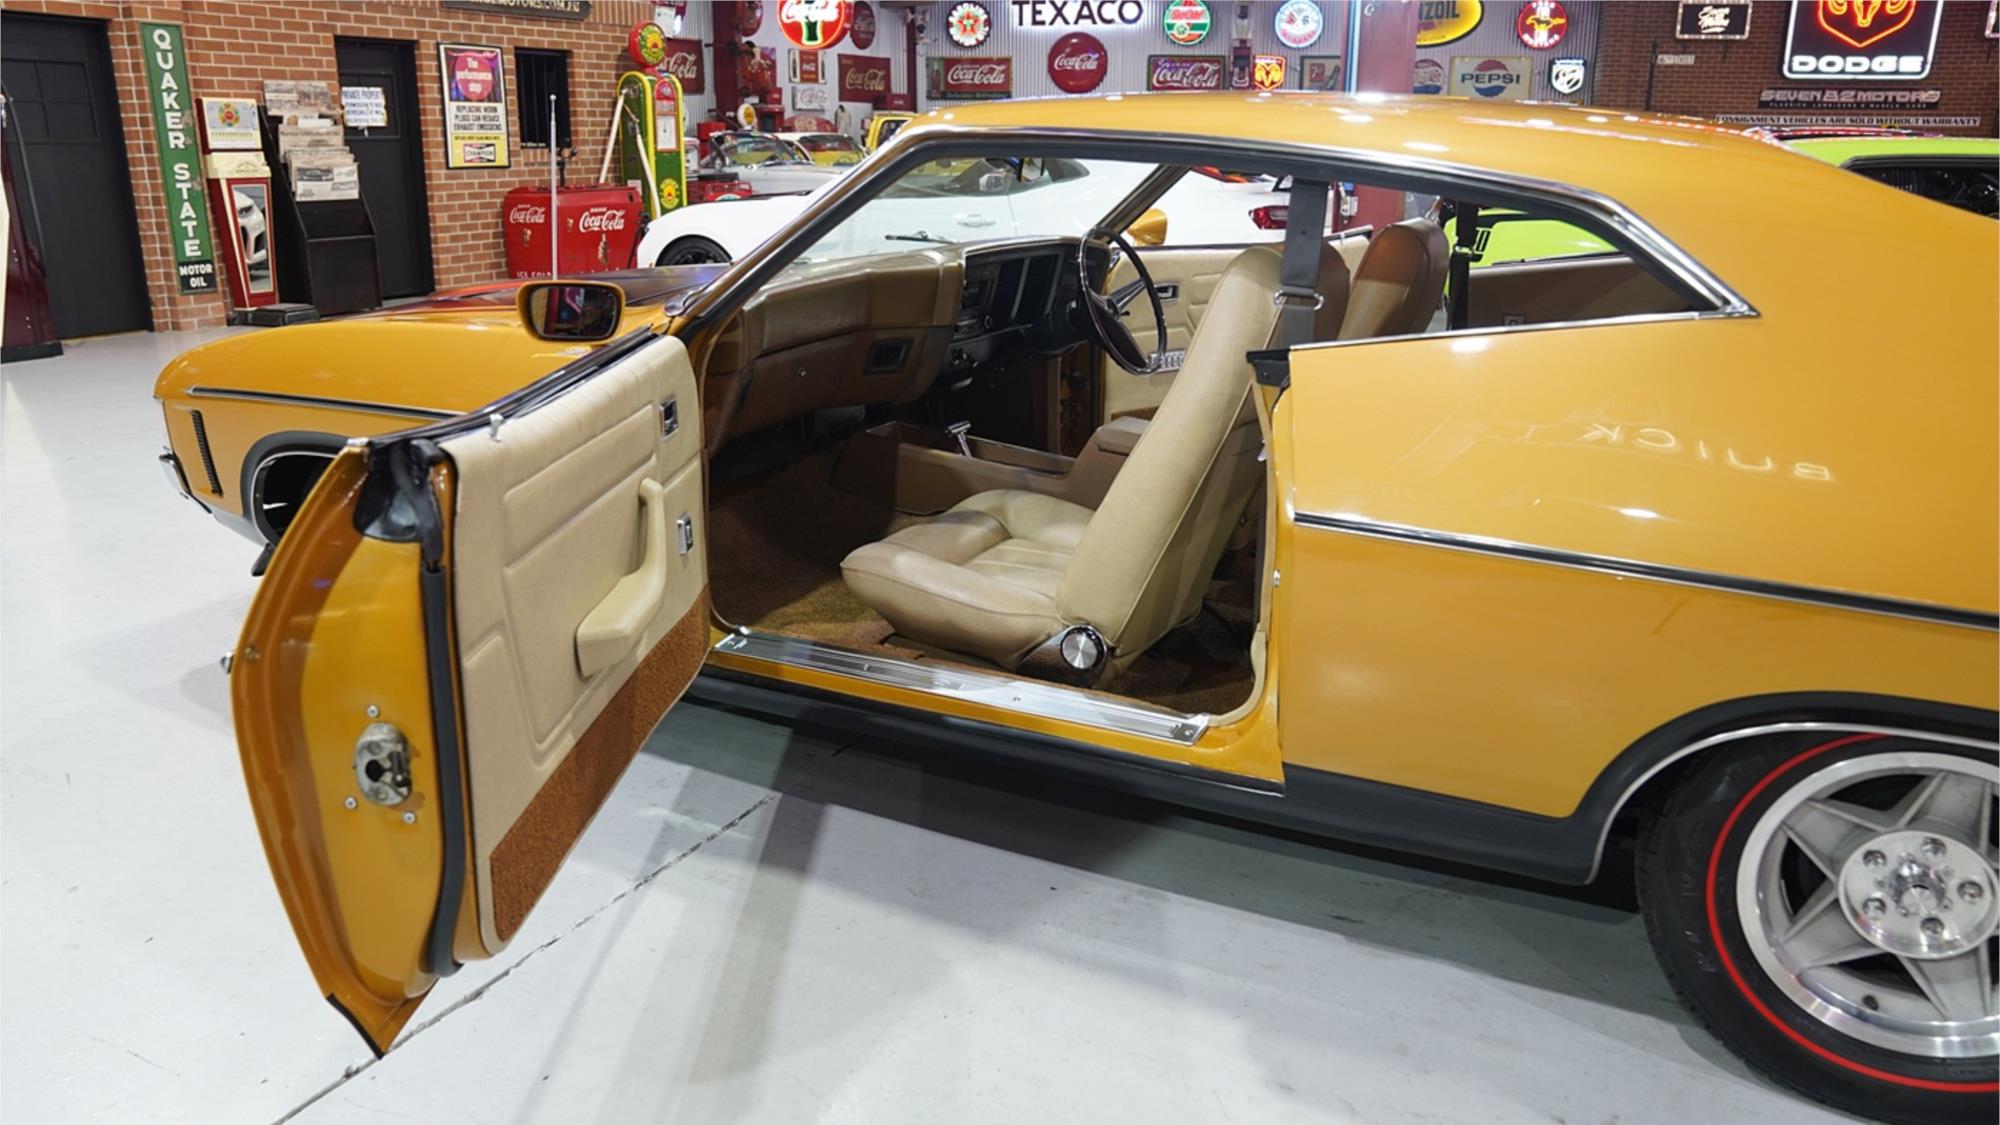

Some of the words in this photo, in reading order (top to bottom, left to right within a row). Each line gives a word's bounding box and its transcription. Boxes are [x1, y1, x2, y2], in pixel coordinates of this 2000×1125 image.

[1012, 0, 1143, 26] TEXACO
[1054, 53, 1099, 70] Coca-Cola
[1791, 55, 1924, 73] DODGE
[845, 68, 885, 91] Coca-Cola
[947, 64, 1007, 85] Coca-Cola
[1153, 62, 1220, 87] Coca-Cola
[1461, 73, 1521, 85] PEPSI
[1781, 116, 1827, 124] VEHICLES
[1829, 116, 1846, 125] ARE
[1848, 117, 1875, 125] SOLD
[1876, 117, 1920, 126] WITHOUT
[1921, 117, 1979, 126] WARRANTY
[153, 29, 186, 149] QUAKER
[173, 162, 201, 257] STATE
[510, 206, 546, 224] Coca-Cola
[579, 209, 626, 233] Coca-Cola
[179, 263, 213, 276] MOTOR
[189, 277, 207, 288] OIL
